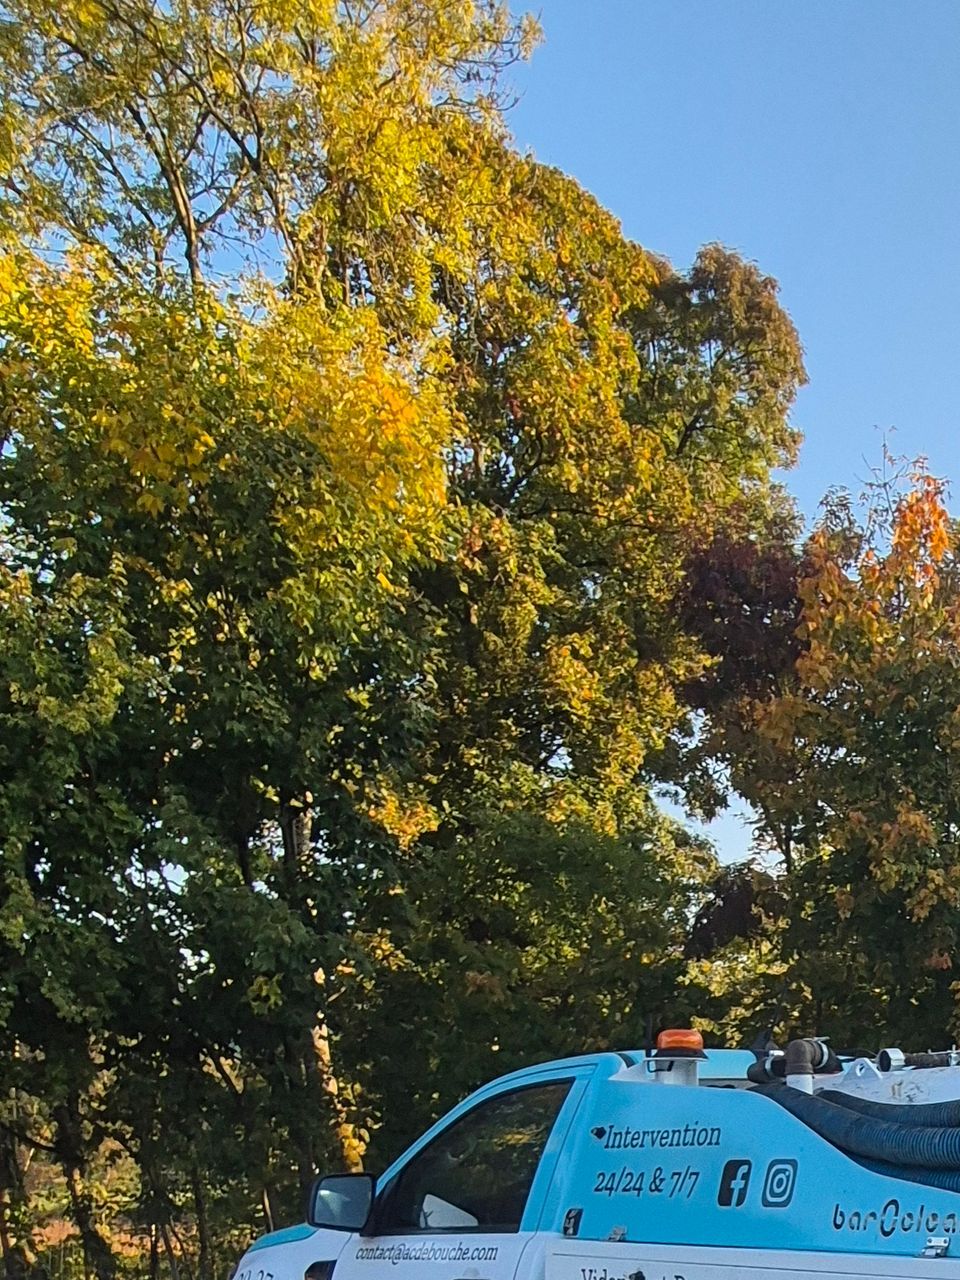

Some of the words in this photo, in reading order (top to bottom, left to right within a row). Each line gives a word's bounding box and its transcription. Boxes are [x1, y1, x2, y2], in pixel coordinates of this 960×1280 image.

[603, 1120, 722, 1150] Intervention
[593, 1166, 645, 1198] 24/24
[648, 1166, 666, 1194] &
[669, 1165, 701, 1199] 7/7
[355, 1242, 500, 1266] contact@acdebouche.com
